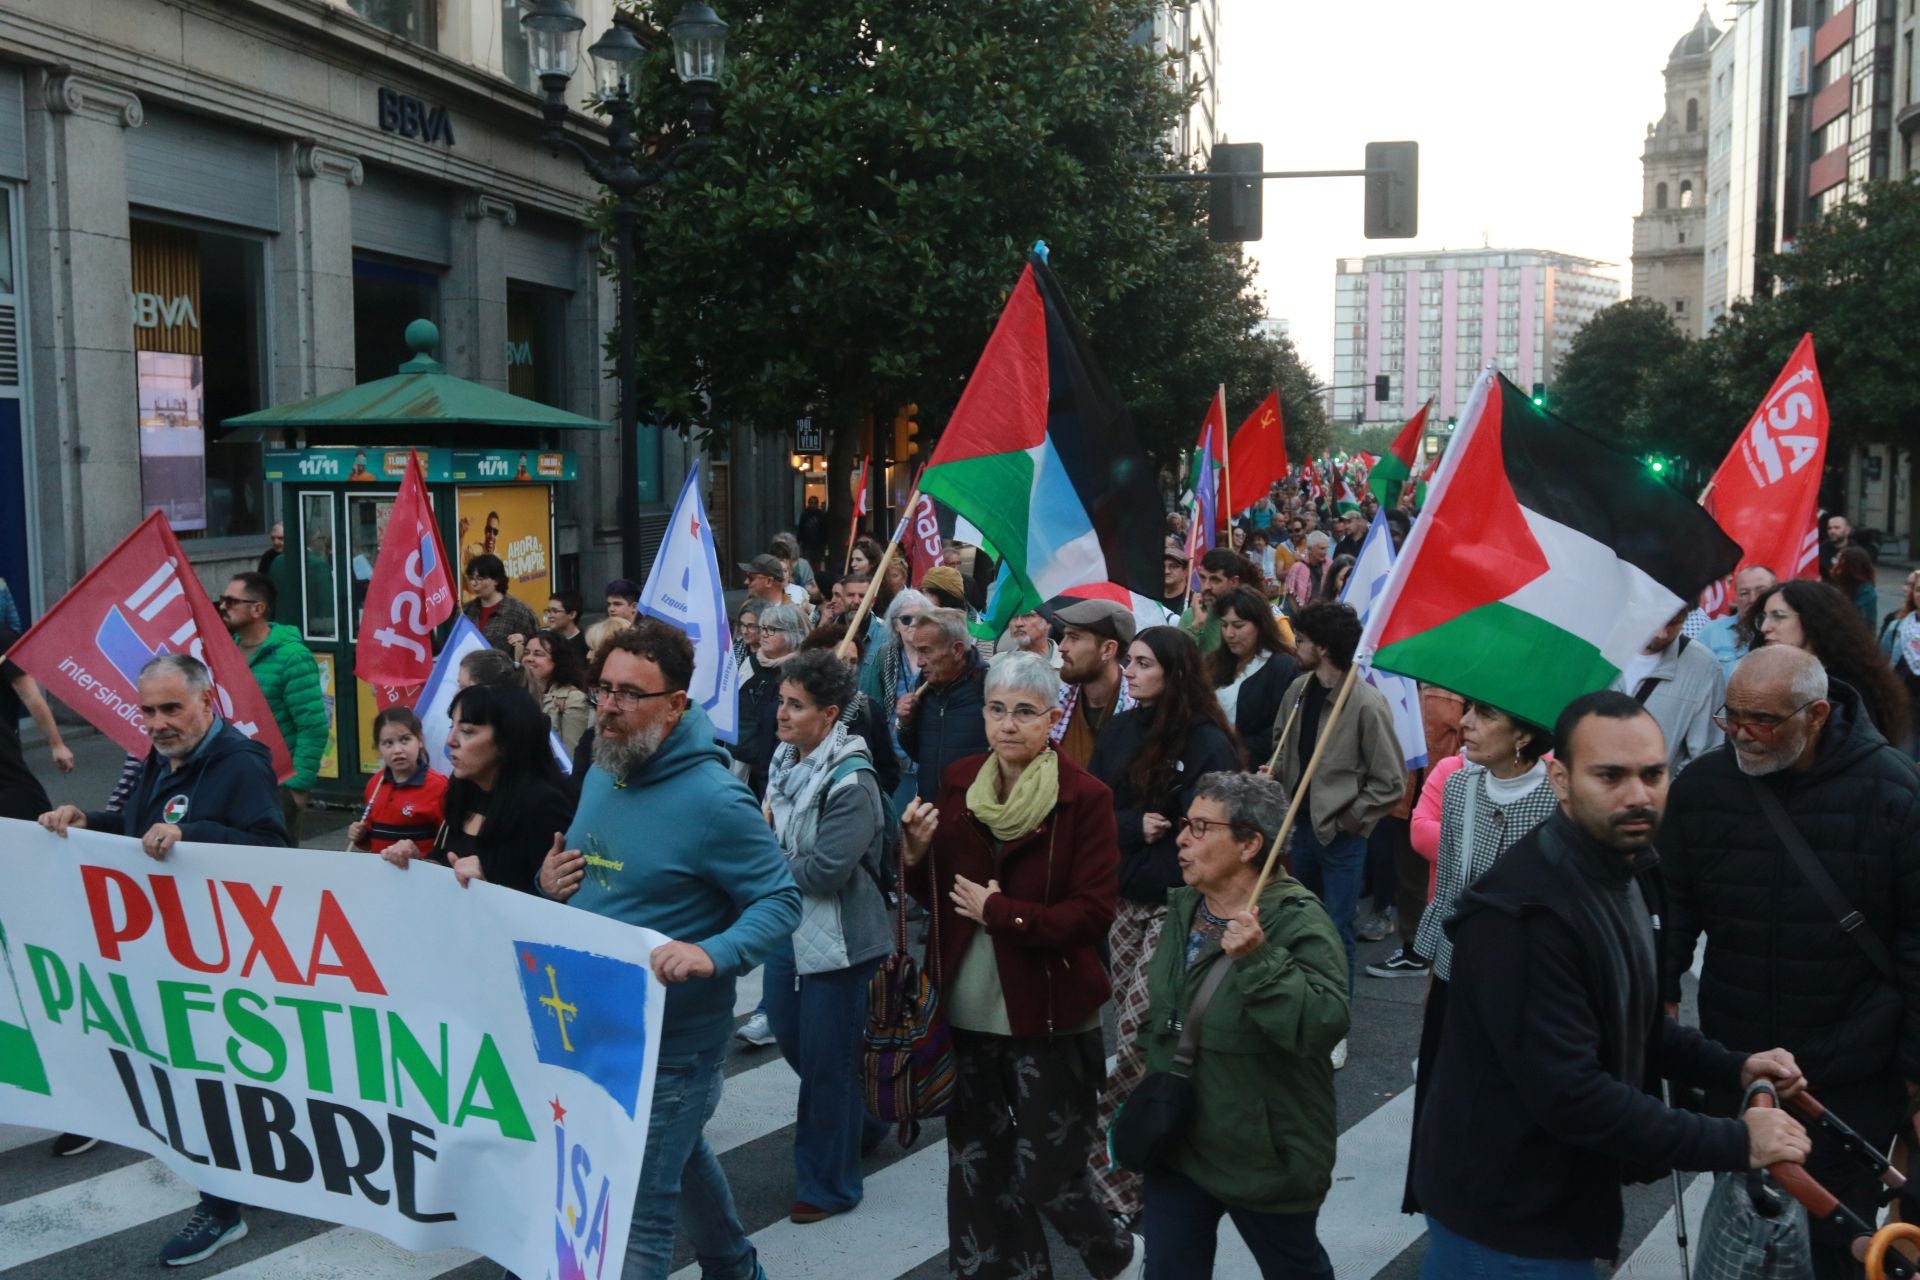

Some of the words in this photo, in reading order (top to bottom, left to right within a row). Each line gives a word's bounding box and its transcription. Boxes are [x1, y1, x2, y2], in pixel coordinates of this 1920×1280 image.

[378, 87, 456, 146] BBVA
[298, 460, 339, 475] 11/11
[477, 460, 509, 476] 11/11
[58, 655, 150, 736] intersindica
[80, 865, 388, 996] PUXA
[25, 943, 536, 1142] PALESTINA
[109, 1048, 457, 1224] LLIBRE
